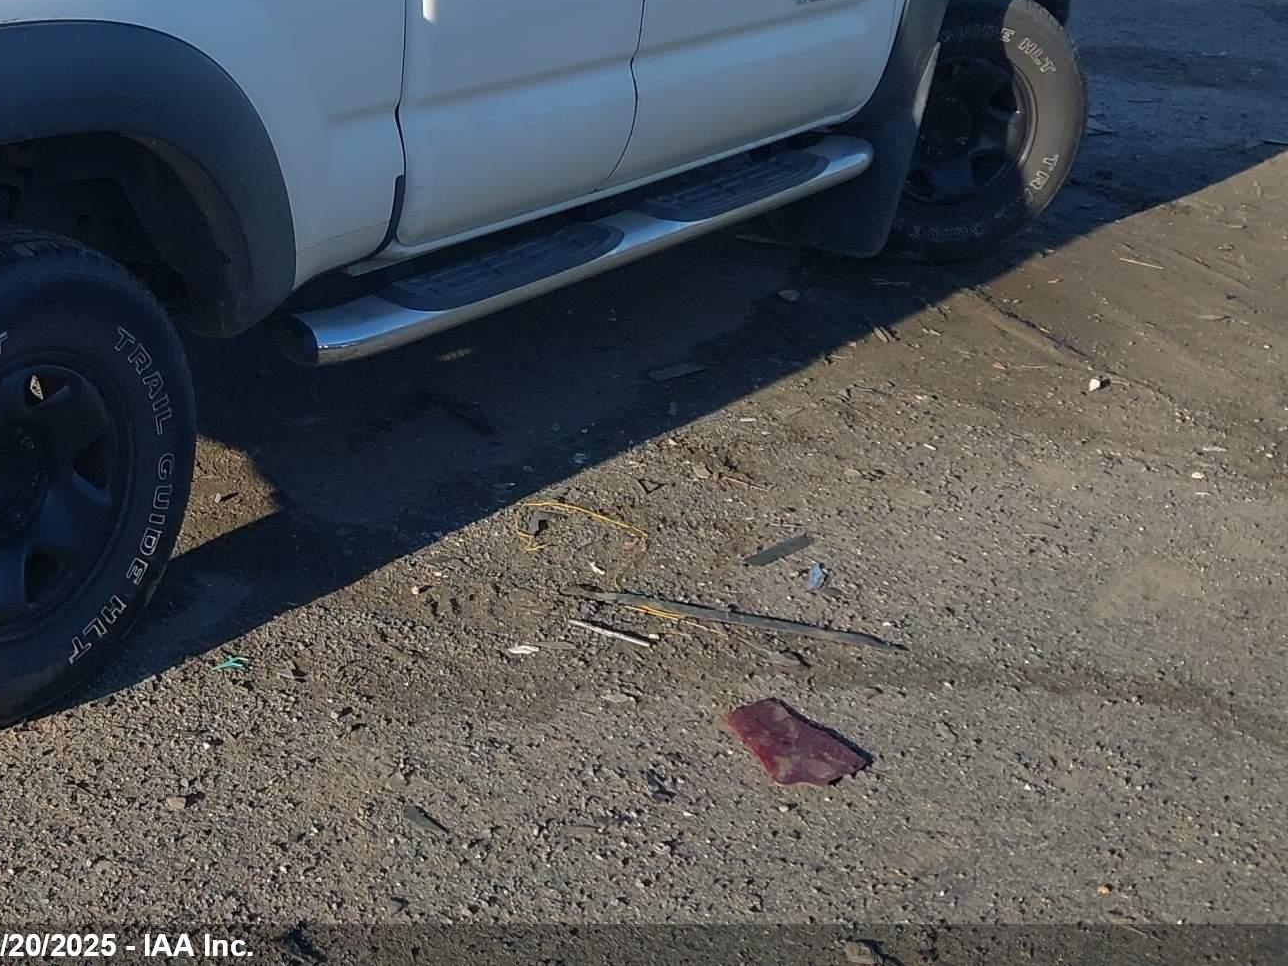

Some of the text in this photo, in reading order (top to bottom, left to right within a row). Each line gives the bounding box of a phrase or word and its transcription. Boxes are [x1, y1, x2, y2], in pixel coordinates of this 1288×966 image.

[68, 326, 175, 664] TRAIL GUIDE HLT
